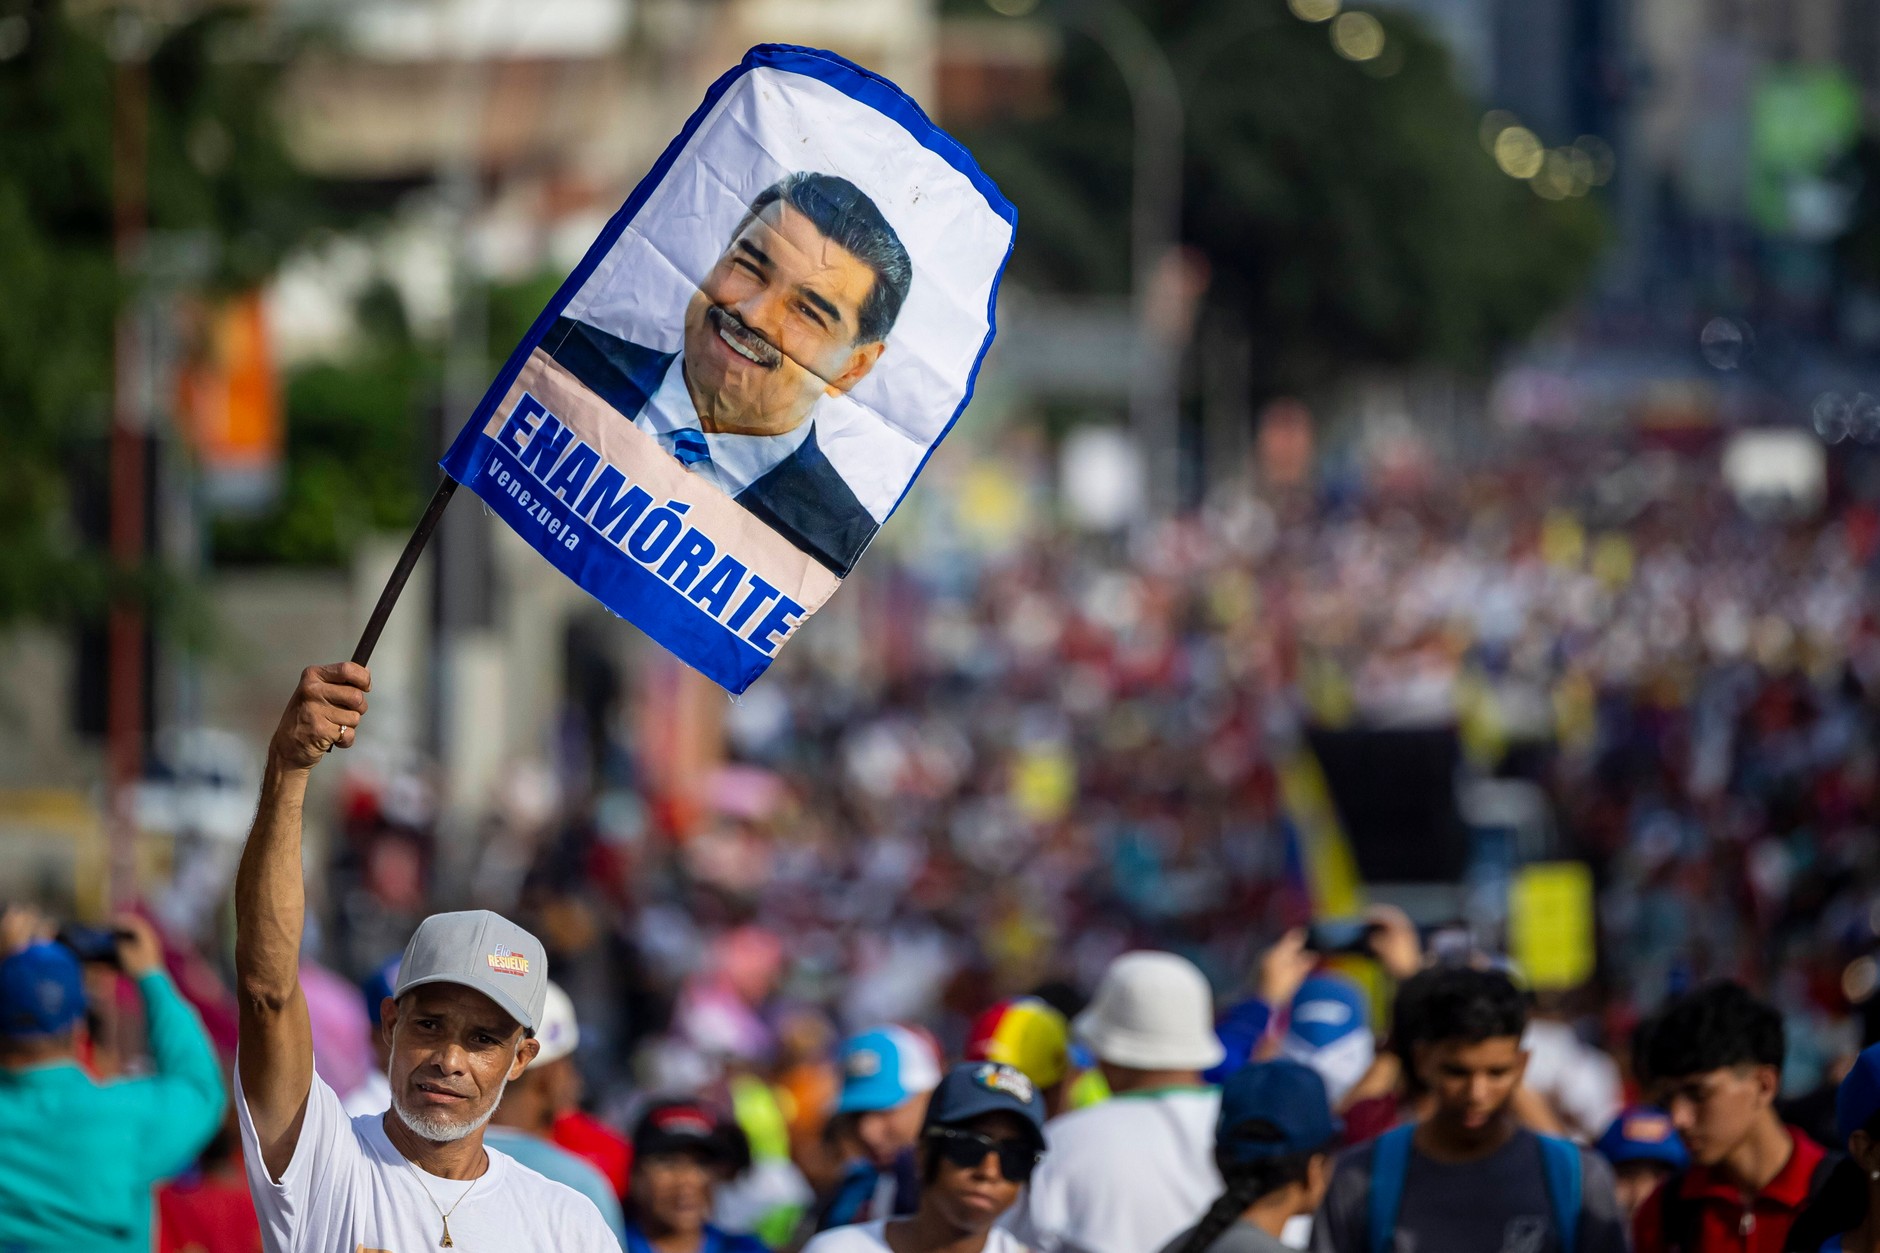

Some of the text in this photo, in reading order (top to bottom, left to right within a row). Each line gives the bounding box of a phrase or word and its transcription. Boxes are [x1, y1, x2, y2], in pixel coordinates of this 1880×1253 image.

[496, 391, 807, 655] ENAMÓRATE
[495, 943, 510, 957] Elio
[487, 954, 529, 973] RESUELVE
